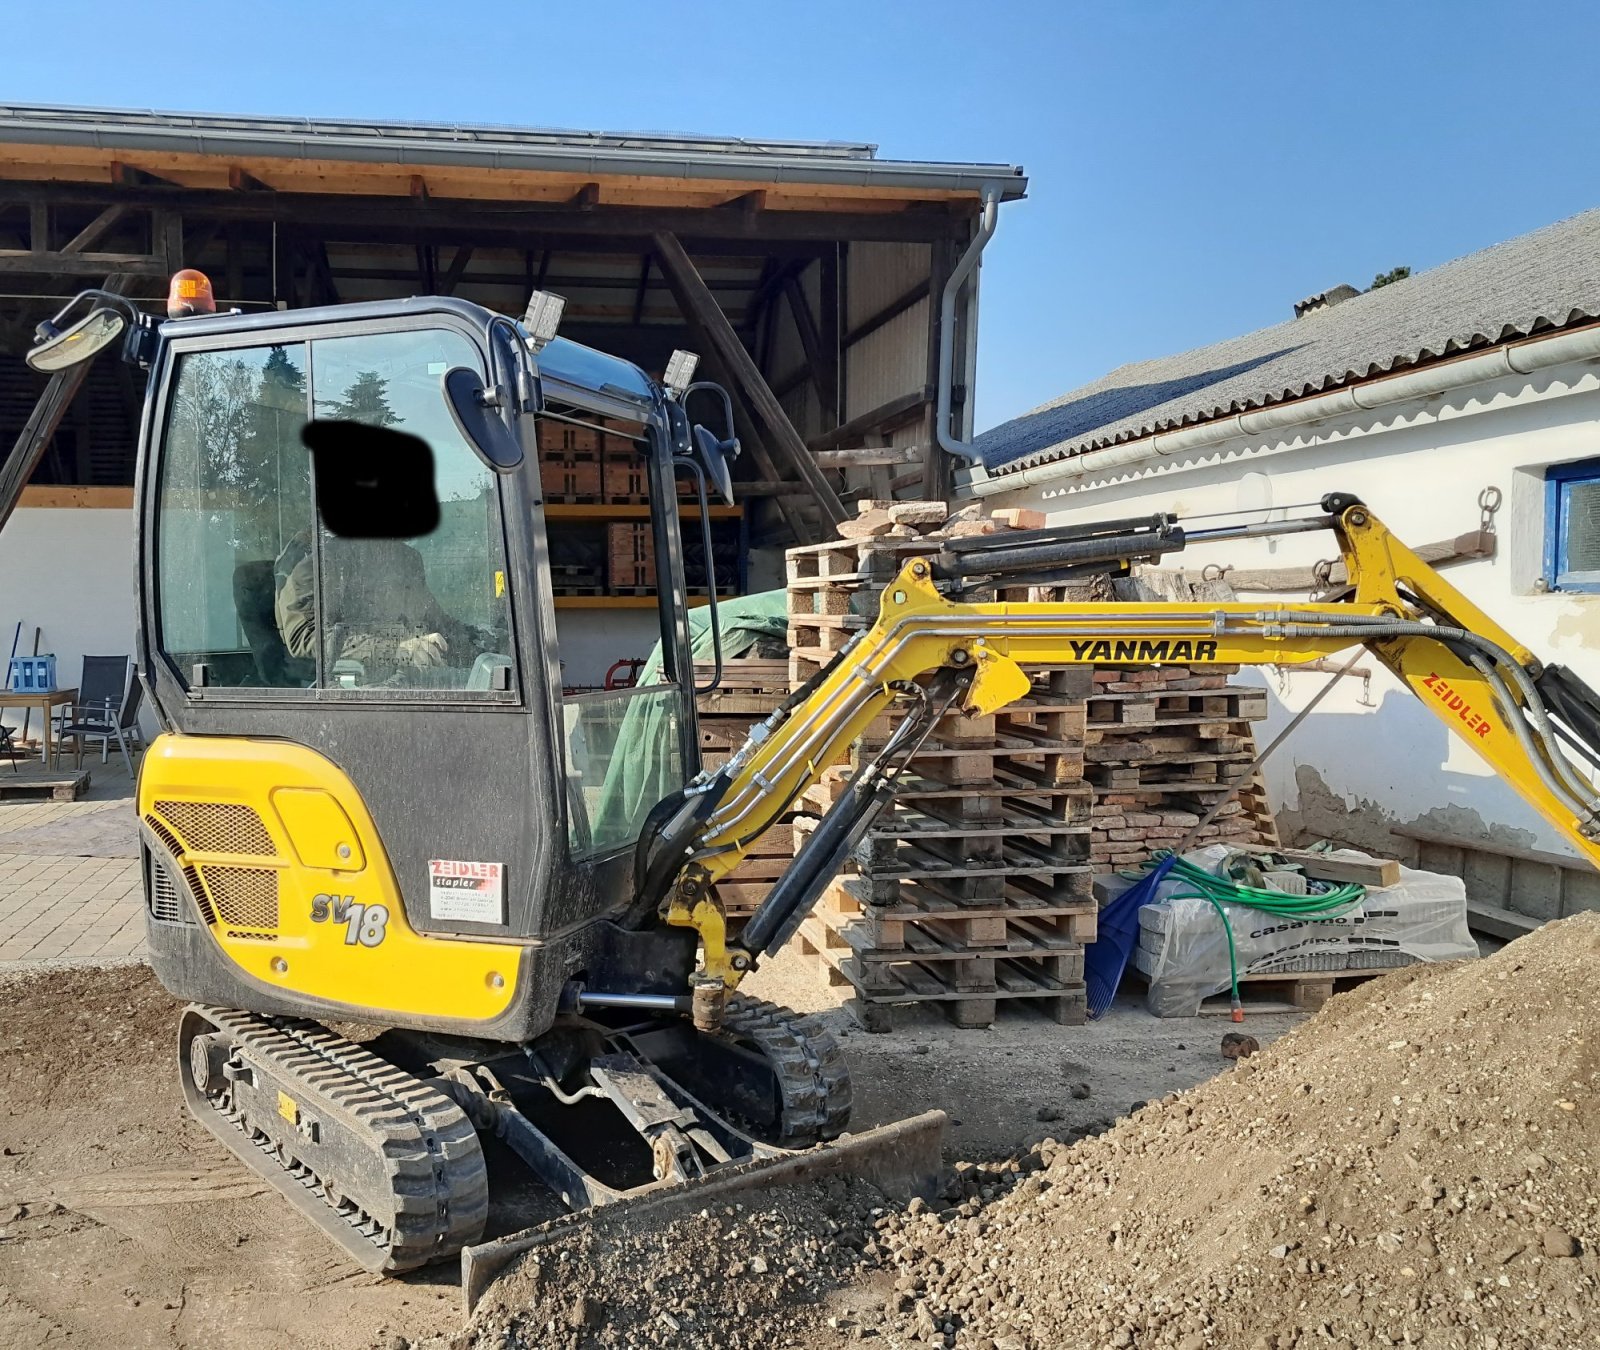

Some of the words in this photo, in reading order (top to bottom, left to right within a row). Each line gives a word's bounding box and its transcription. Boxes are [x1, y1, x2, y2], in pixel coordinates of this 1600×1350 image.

[1069, 640, 1218, 661] YANMAR
[1423, 671, 1491, 738] ZEIDLER
[432, 861, 499, 878] ZEIDLER
[435, 878, 475, 888] stapler
